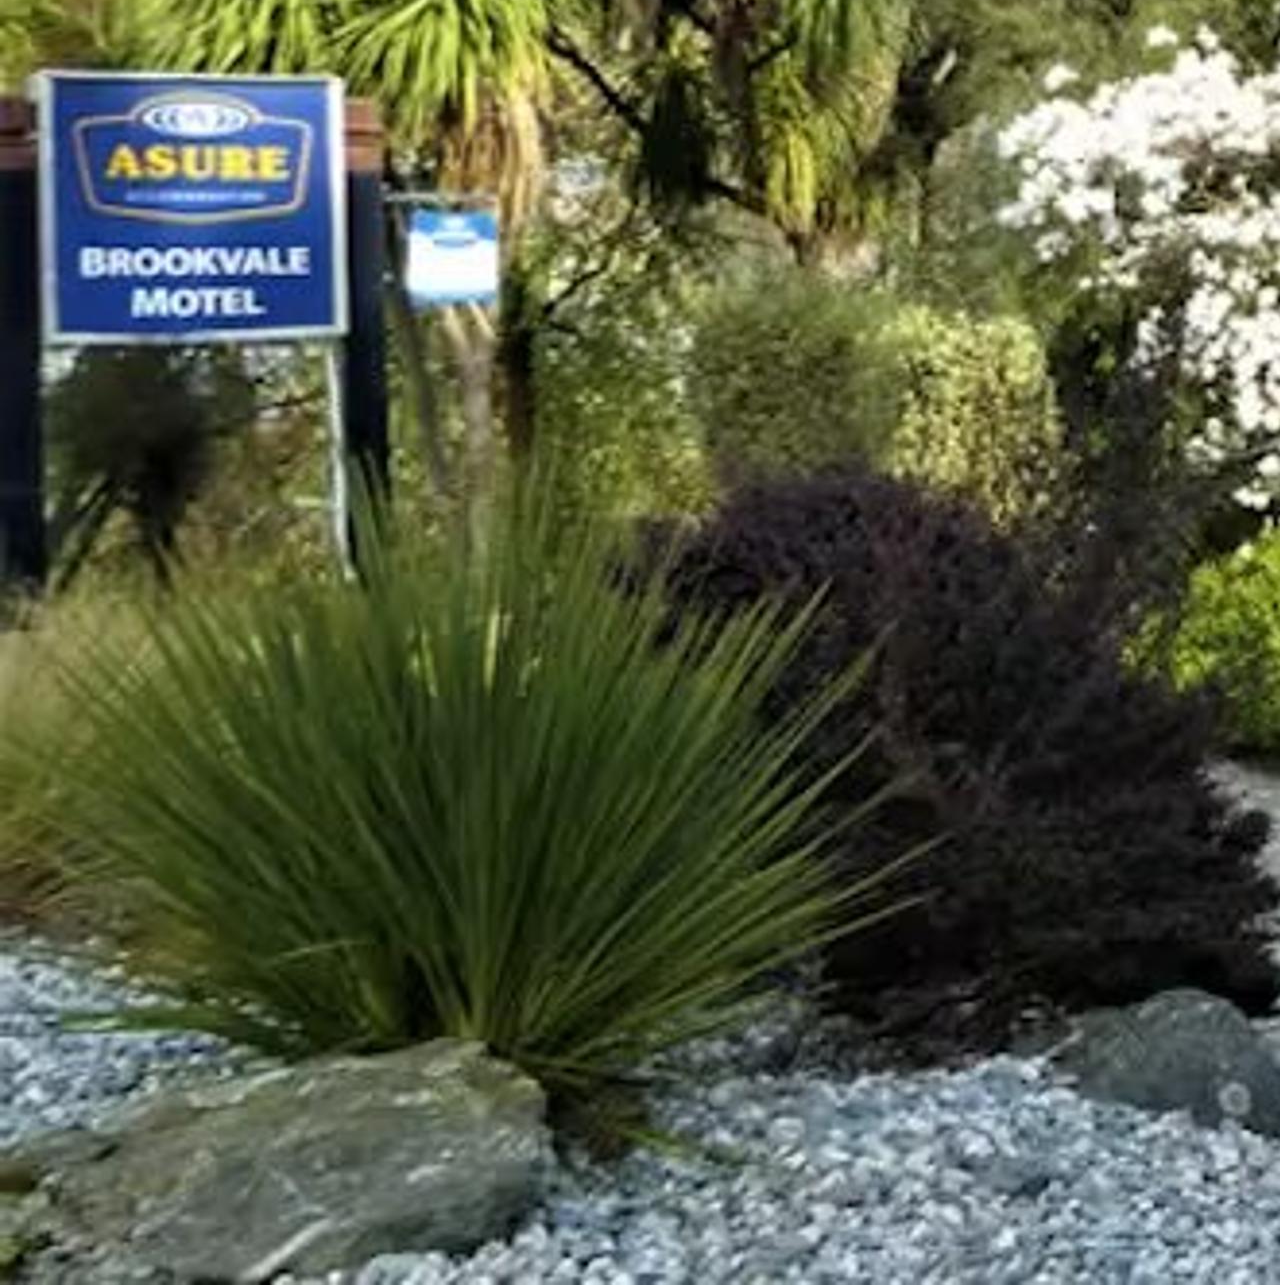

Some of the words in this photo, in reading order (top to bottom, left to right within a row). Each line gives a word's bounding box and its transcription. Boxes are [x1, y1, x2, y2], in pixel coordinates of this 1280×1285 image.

[105, 143, 291, 181] ASURE
[79, 246, 311, 279] BROOKVALE
[130, 287, 266, 318] MOTEL
